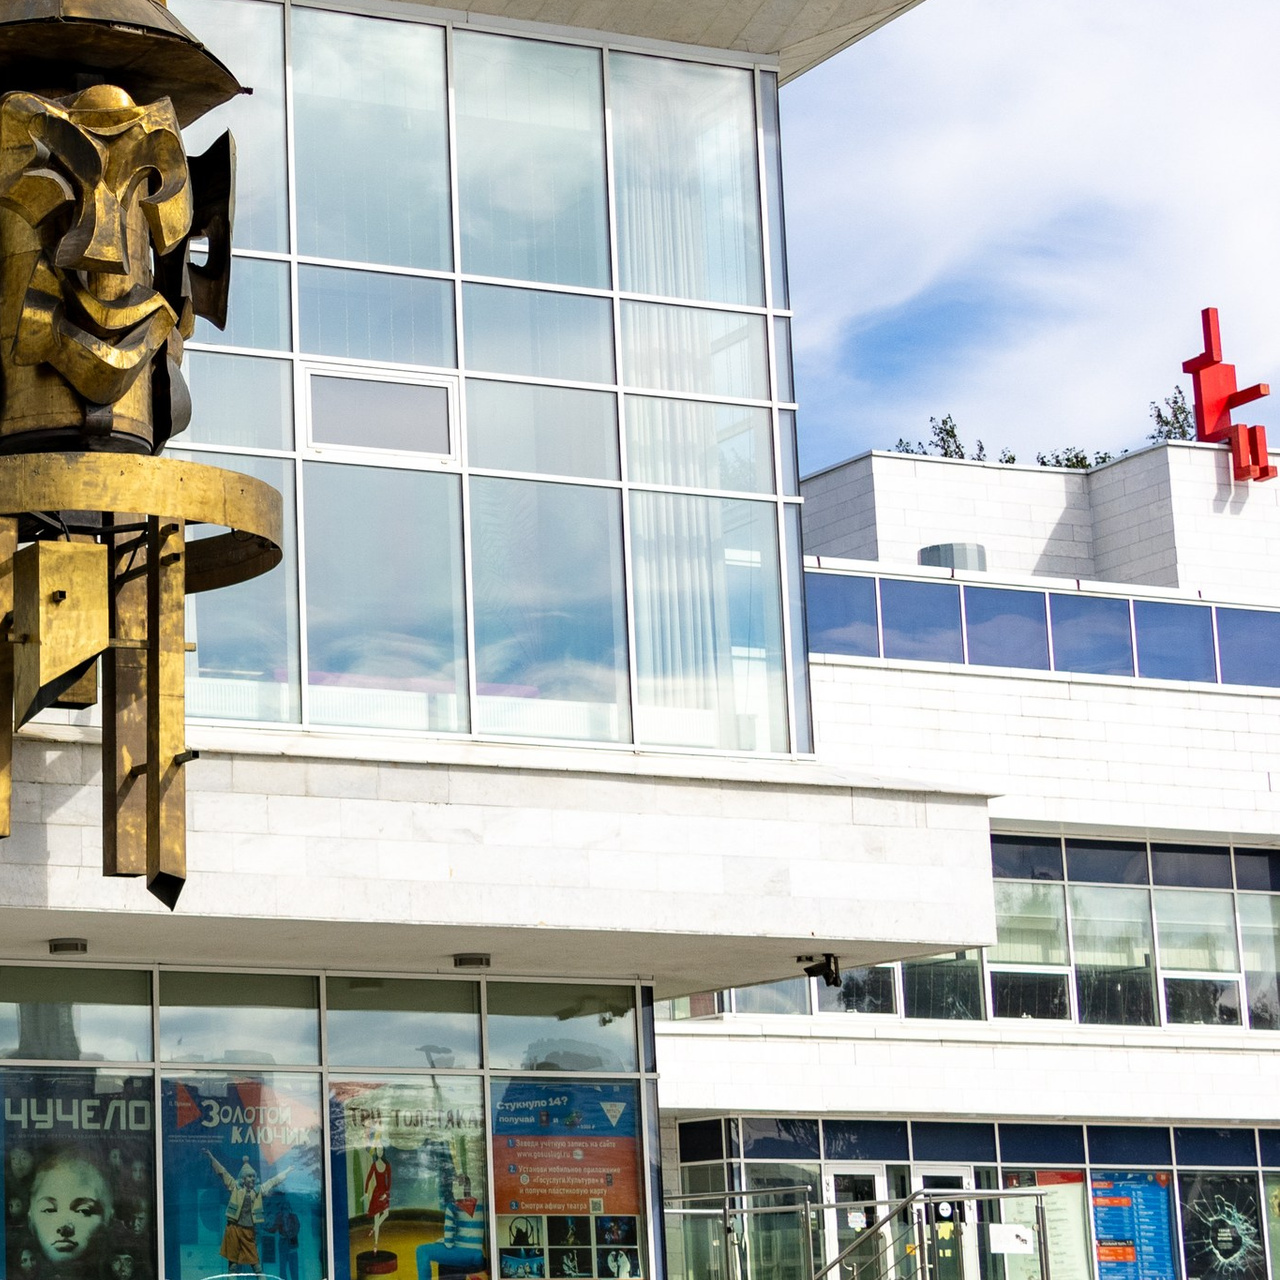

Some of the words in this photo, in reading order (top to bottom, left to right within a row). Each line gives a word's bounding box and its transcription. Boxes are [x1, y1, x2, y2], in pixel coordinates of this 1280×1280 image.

[496, 1100, 547, 1111] Стукнуло
[548, 1096, 568, 1106] 14?
[4, 1098, 151, 1130] ЧУЧЕЛО
[348, 1107, 382, 1127] ТРИ
[391, 1109, 479, 1129] ТОЛСТЯКА
[499, 1115, 535, 1124] получай
[231, 1126, 311, 1145] КЛЮЧИК
[599, 1140, 616, 1148] сайте
[517, 1150, 570, 1159] www.gosuslugi.ru
[518, 1165, 547, 1173] Установи
[548, 1188, 589, 1196] пластиковую
